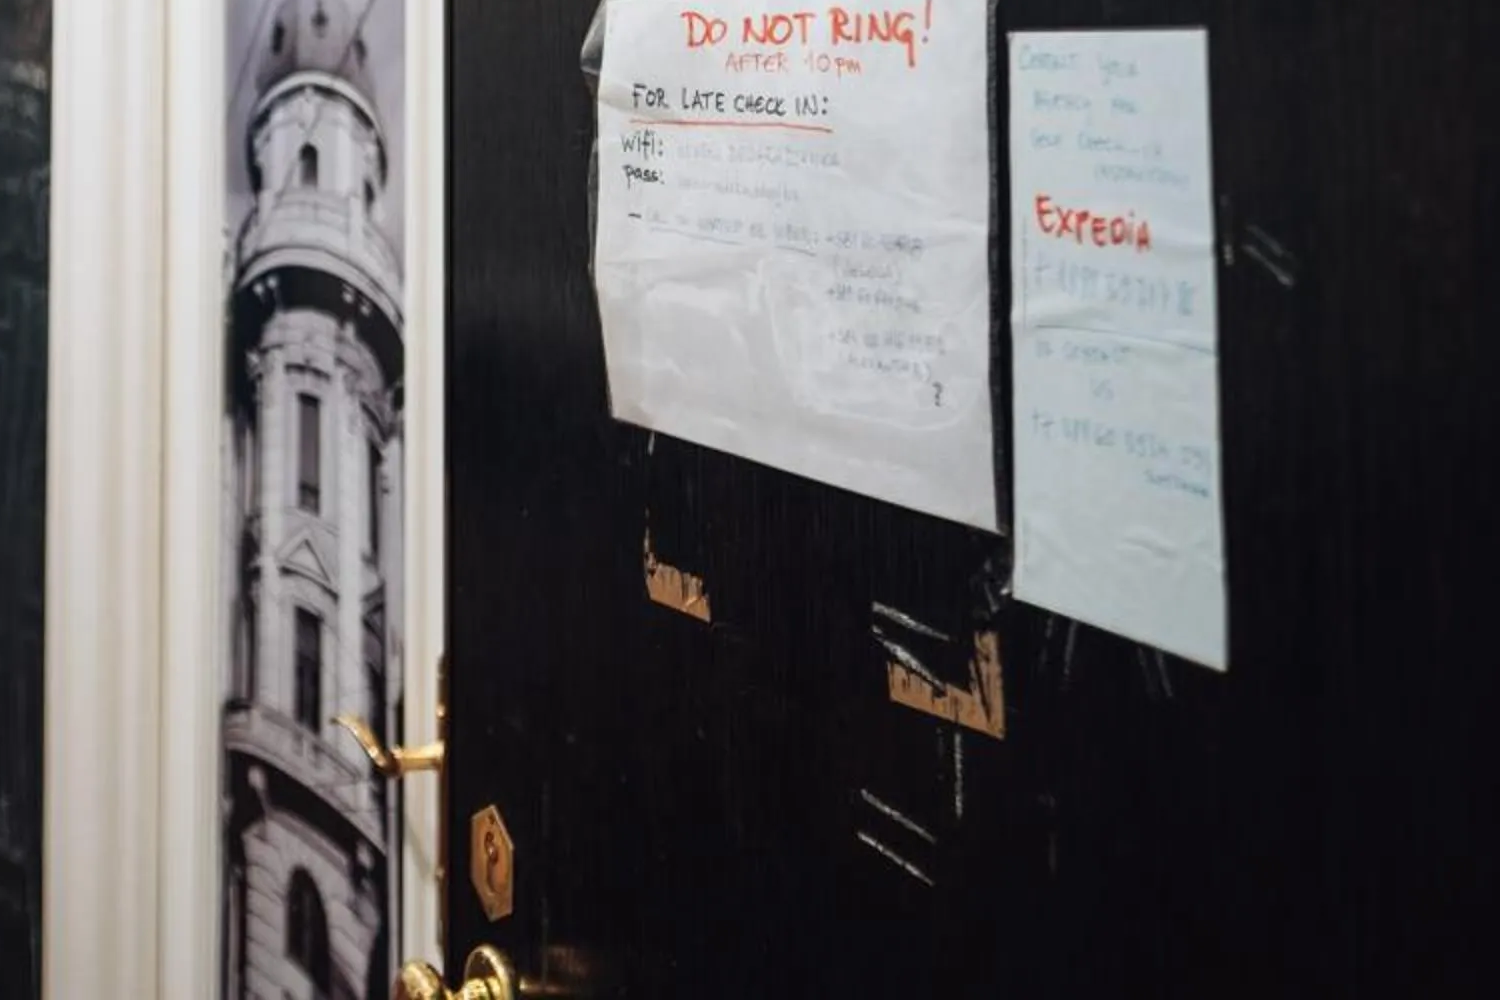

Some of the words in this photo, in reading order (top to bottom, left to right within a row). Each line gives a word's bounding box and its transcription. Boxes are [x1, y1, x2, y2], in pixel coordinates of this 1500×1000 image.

[681, 10, 728, 48] DO
[742, 12, 816, 45] NOT
[725, 53, 789, 73] AFTER
[804, 53, 831, 73] 10
[632, 83, 669, 109] FOR
[681, 87, 725, 113] LATE
[733, 96, 786, 117] CHECK
[796, 96, 829, 115] IN:
